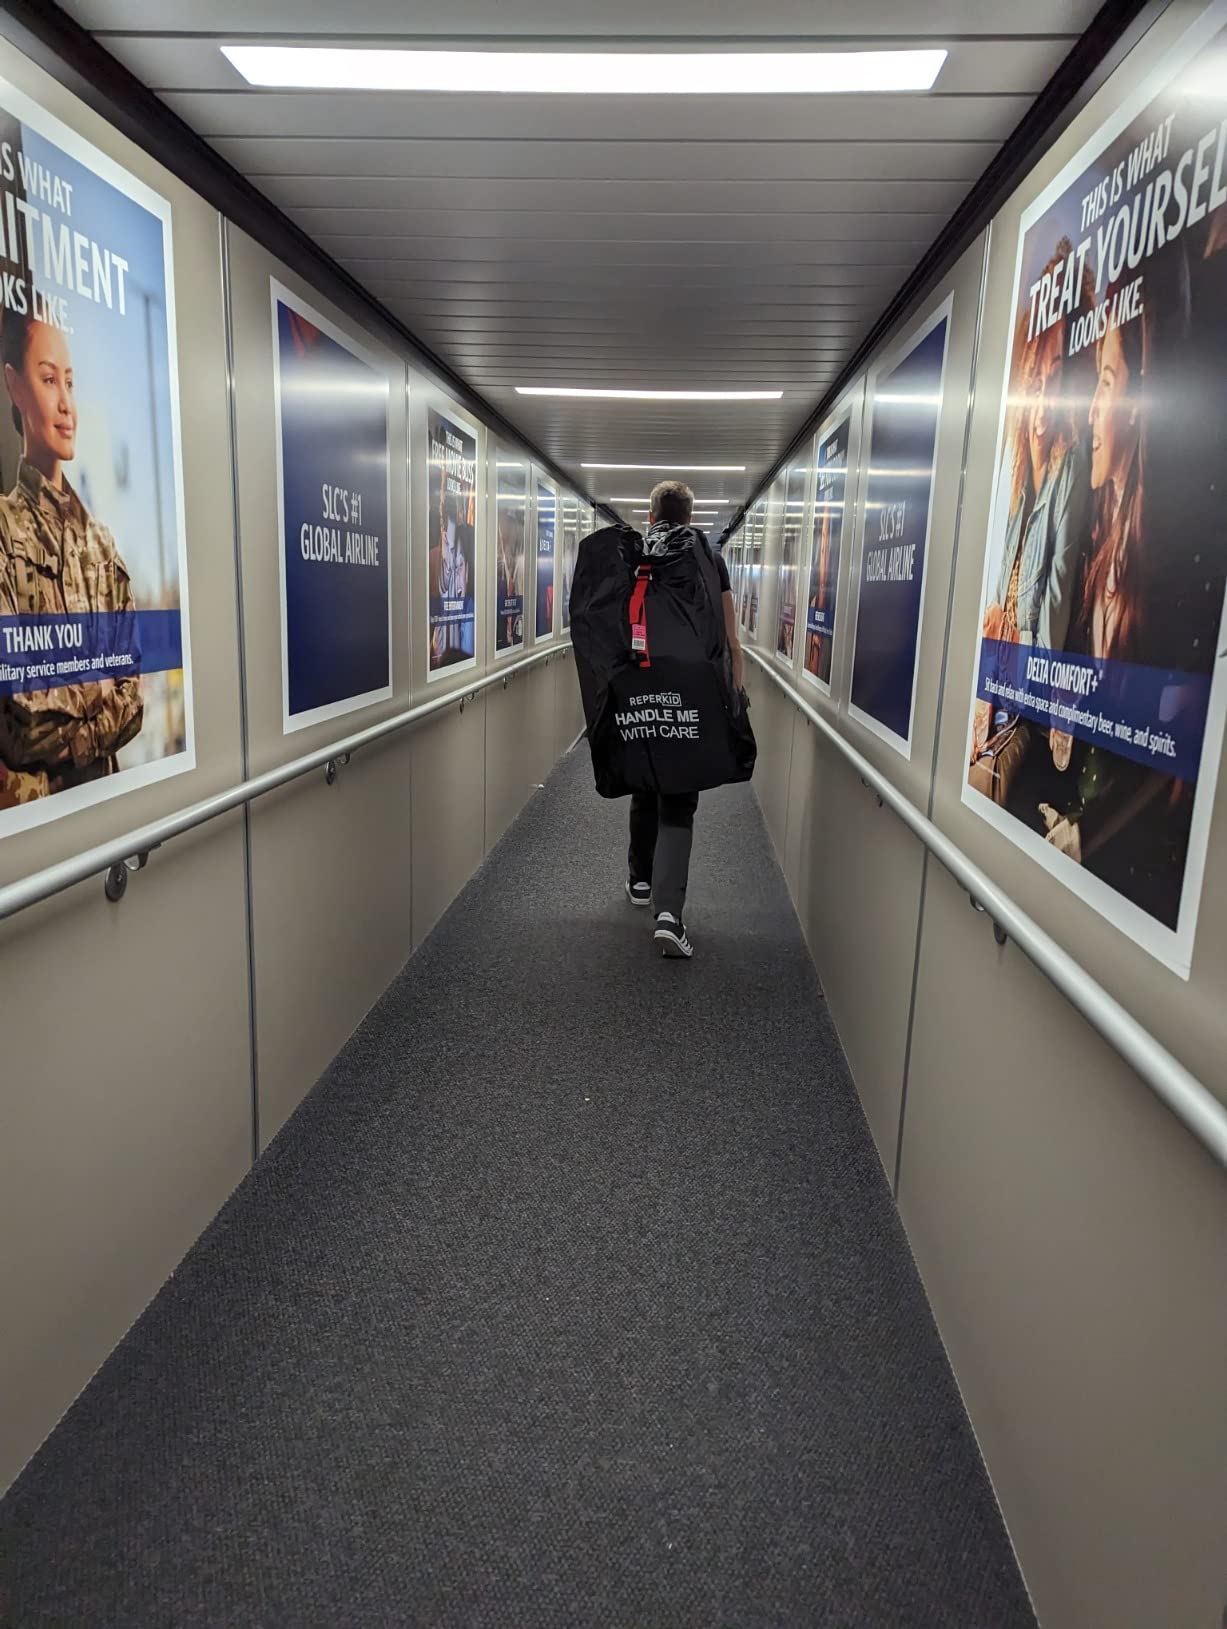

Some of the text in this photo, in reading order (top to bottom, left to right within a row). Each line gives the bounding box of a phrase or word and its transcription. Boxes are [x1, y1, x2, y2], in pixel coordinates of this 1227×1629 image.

[0, 142, 72, 216] S WHAT
[1080, 113, 1175, 232] THIS IS WHAT
[0, 191, 129, 315] ITMENT
[32, 285, 74, 335] LIKE.
[1027, 235, 1091, 343] TREAT
[1068, 277, 1144, 356] LOOKS LIKE.
[351, 492, 362, 526] #1
[300, 522, 379, 566] GLOBAL AIRLINE
[866, 543, 916, 582] GLOBAL AIRLINE
[3, 623, 82, 653] THANK YOU
[27, 660, 55, 678] service
[56, 655, 90, 675] members
[91, 653, 104, 669] and
[104, 653, 134, 667] veterans.
[1026, 656, 1049, 685] DELTA
[615, 709, 700, 726] HANDLE ME
[620, 725, 700, 742] WITH CARE
[1015, 687, 1024, 703] with
[1024, 692, 1036, 708] extra
[1035, 695, 1049, 713] space
[1048, 699, 1059, 715] and
[1058, 702, 1099, 734] complimentary
[1098, 711, 1114, 738] beer,
[1114, 719, 1133, 744] wine,
[1133, 726, 1149, 748] and
[1148, 731, 1177, 758] spirits.
